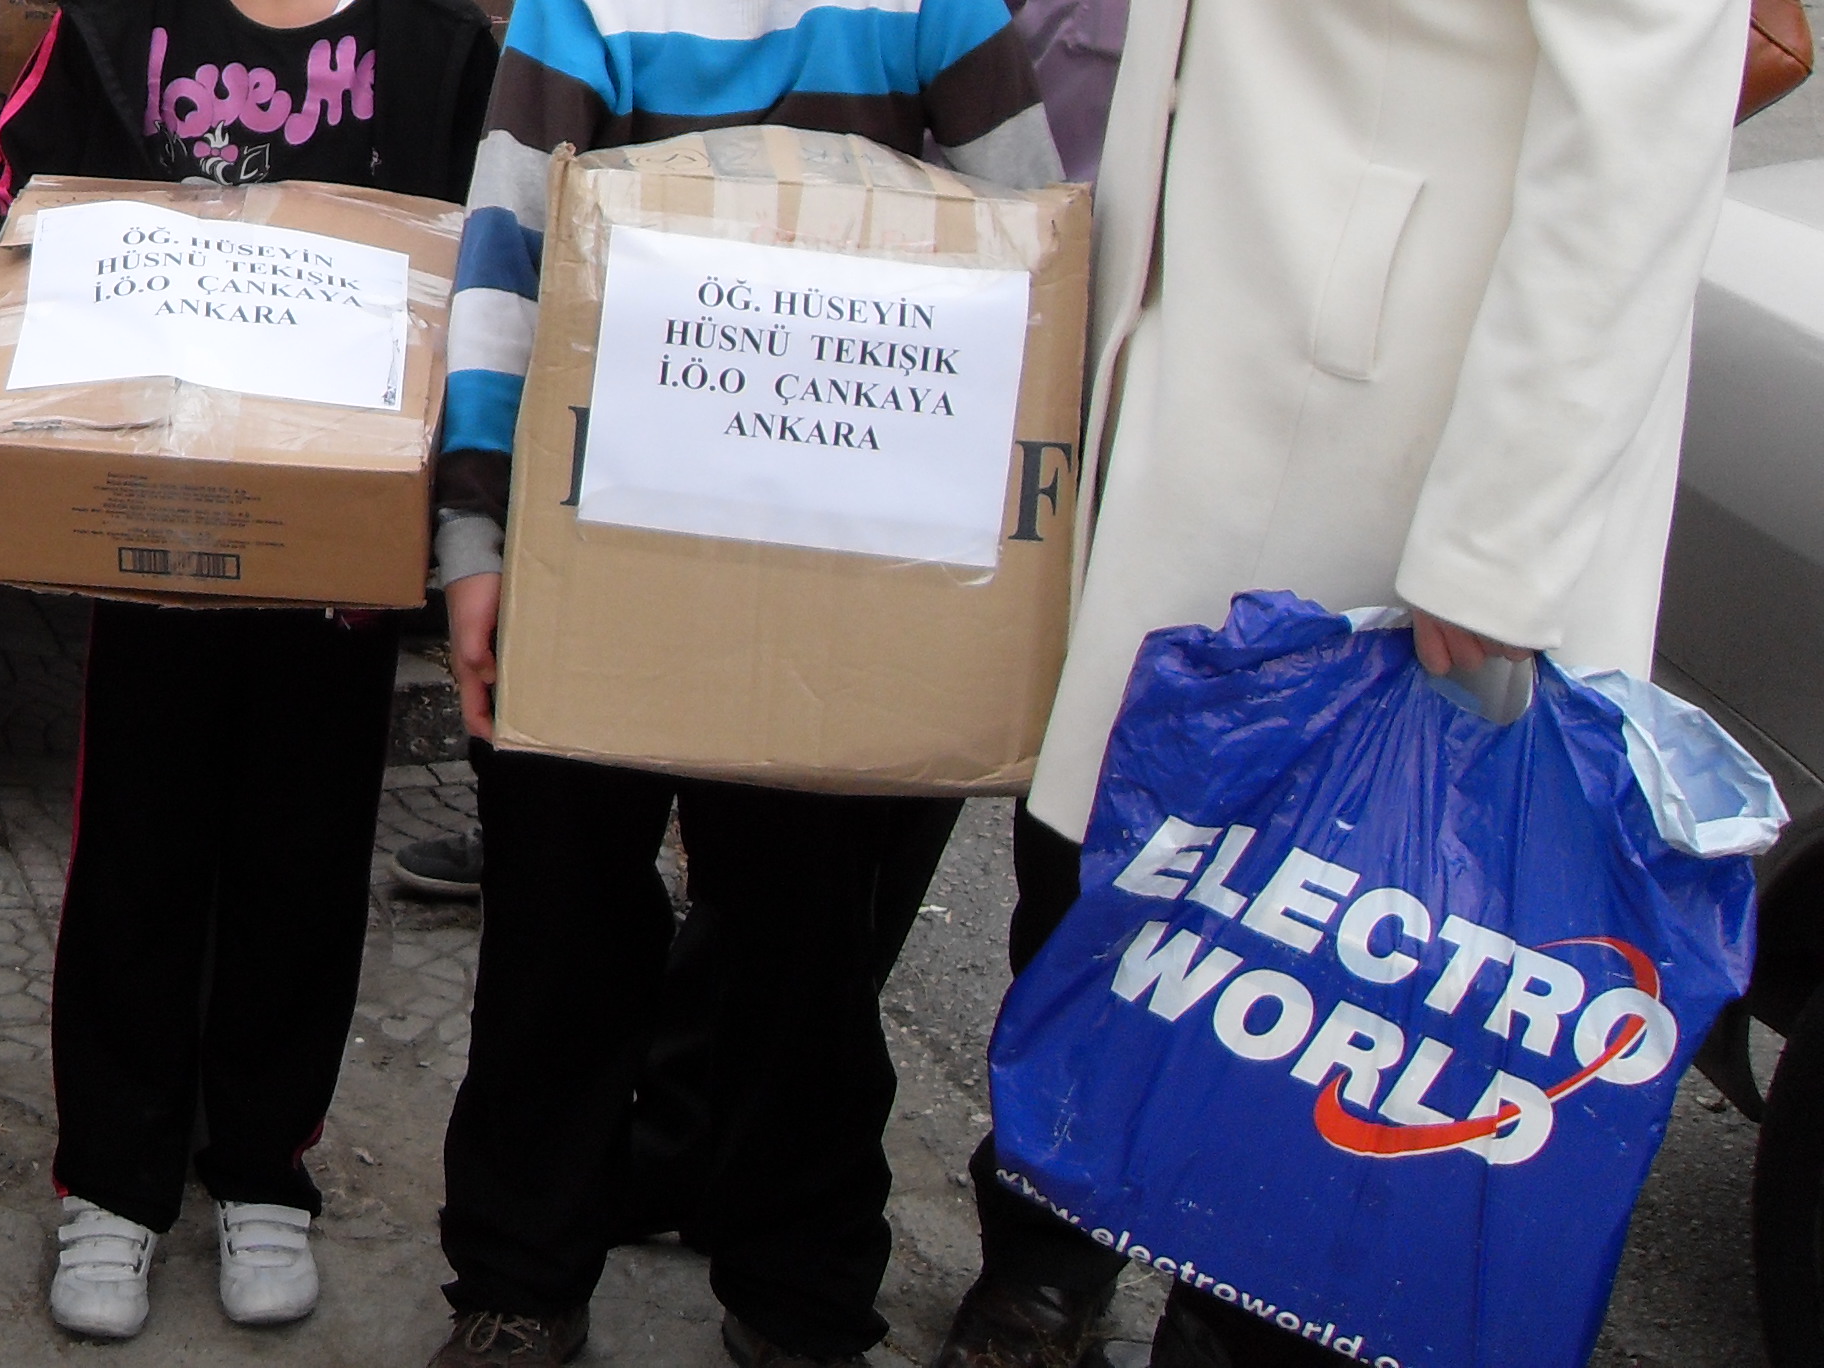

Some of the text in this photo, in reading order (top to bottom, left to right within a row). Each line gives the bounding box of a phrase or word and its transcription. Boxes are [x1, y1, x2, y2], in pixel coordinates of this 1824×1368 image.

[97, 249, 361, 292] HÜSNÜ TEKIŞIK
[122, 226, 333, 269] ÖĞ. HÜSEYİN
[155, 297, 299, 326] ANKARA
[197, 274, 364, 309] ÇANKAYA
[697, 275, 936, 331] ÖĞ. HÜSEYİN
[664, 316, 962, 379] HÜSNÜ TEKIŞIK
[657, 353, 956, 418] İ.Ö.O ÇANKAYA
[724, 411, 882, 452] ANKARA
[1112, 814, 1678, 1086] ELECTRO
[1110, 920, 1555, 1166] WORLD
